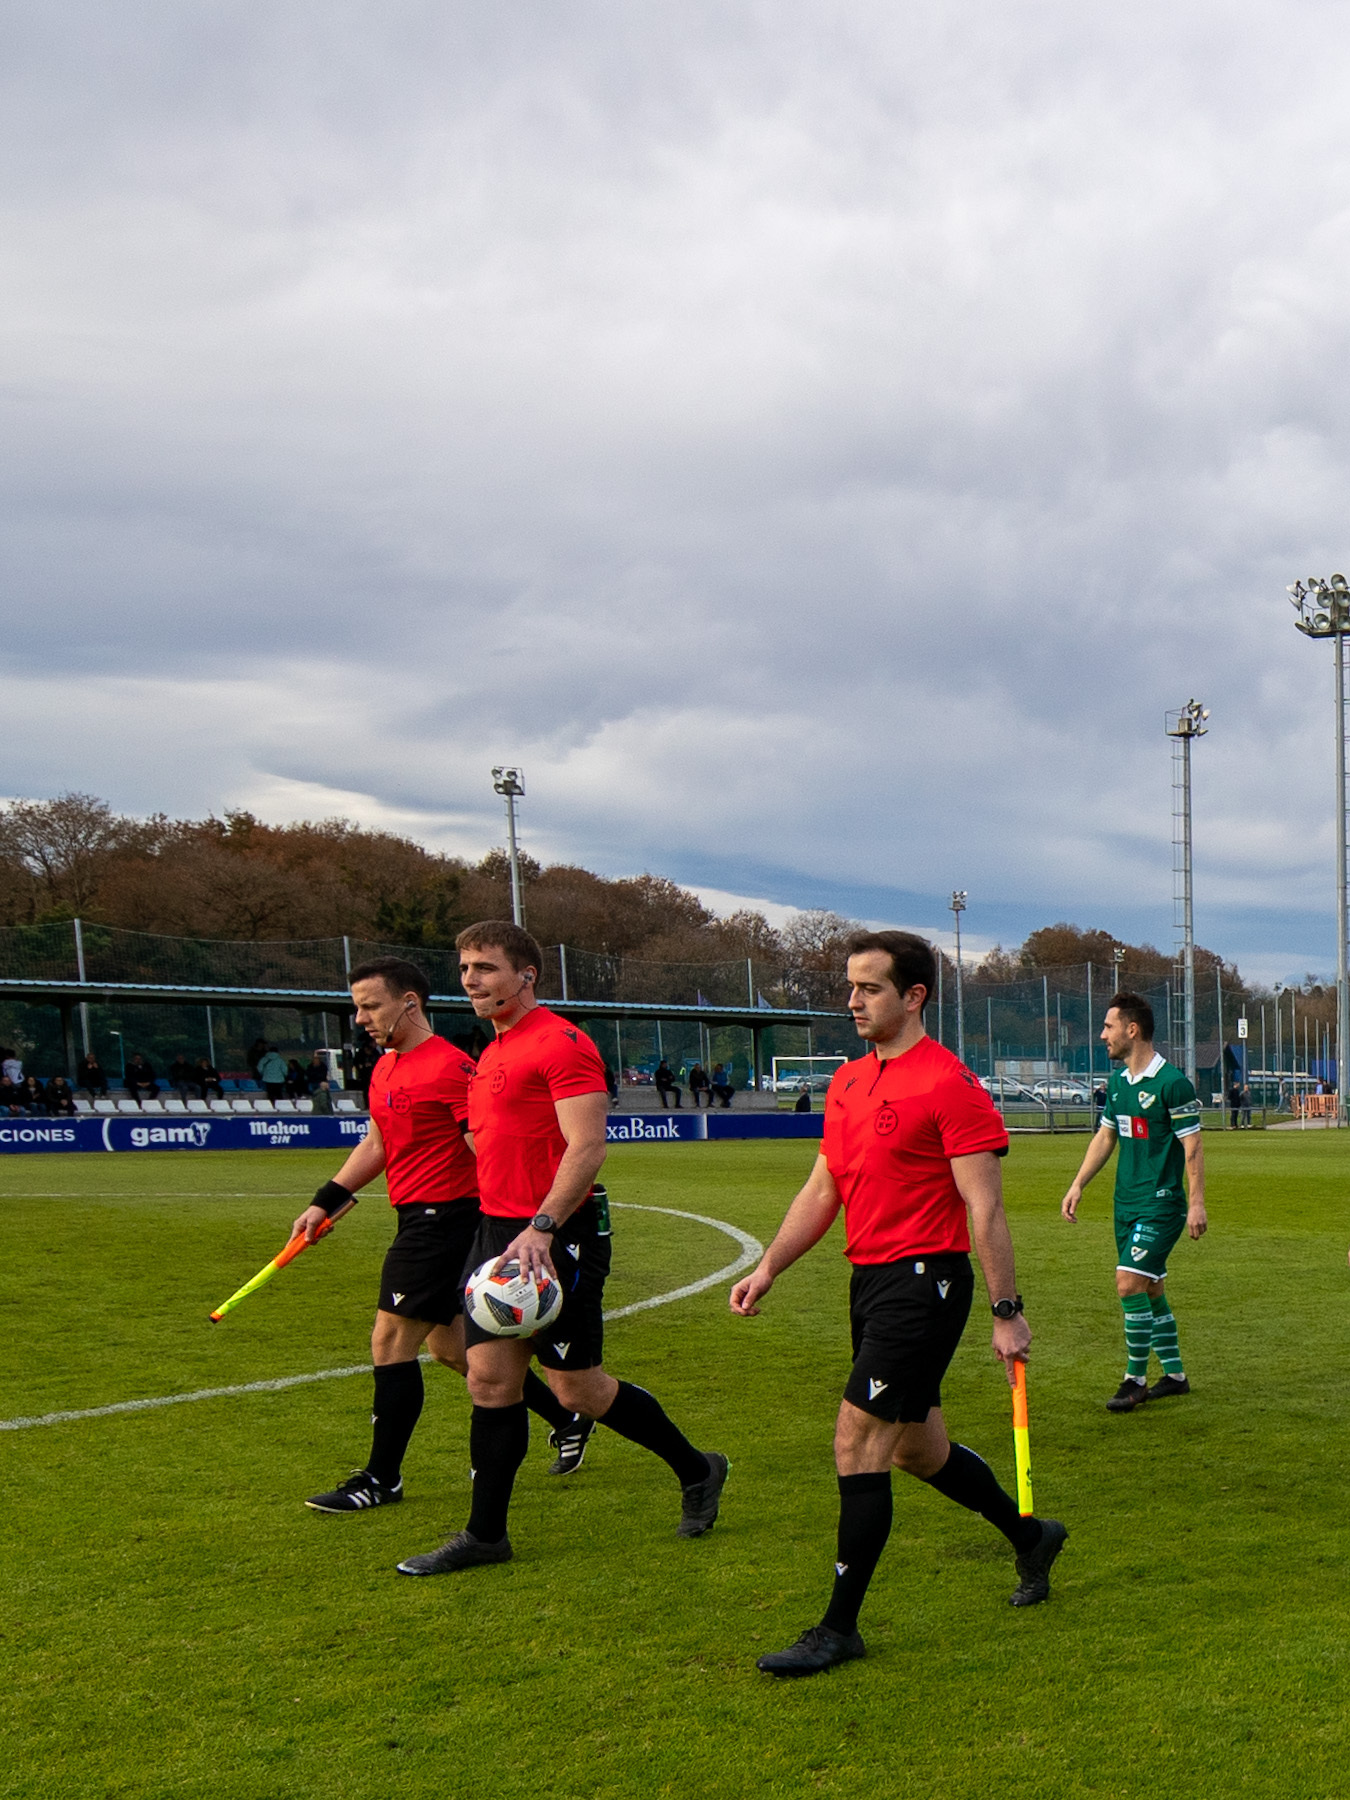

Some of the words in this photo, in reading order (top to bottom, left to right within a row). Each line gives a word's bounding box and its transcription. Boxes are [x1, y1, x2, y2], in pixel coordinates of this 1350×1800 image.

[1240, 1027, 1246, 1036] 3
[249, 1121, 310, 1135] Mahou
[606, 1117, 680, 1139] xaBank
[0, 1129, 76, 1142] CIONES
[130, 1127, 195, 1147] gam
[270, 1135, 291, 1145] SIN
